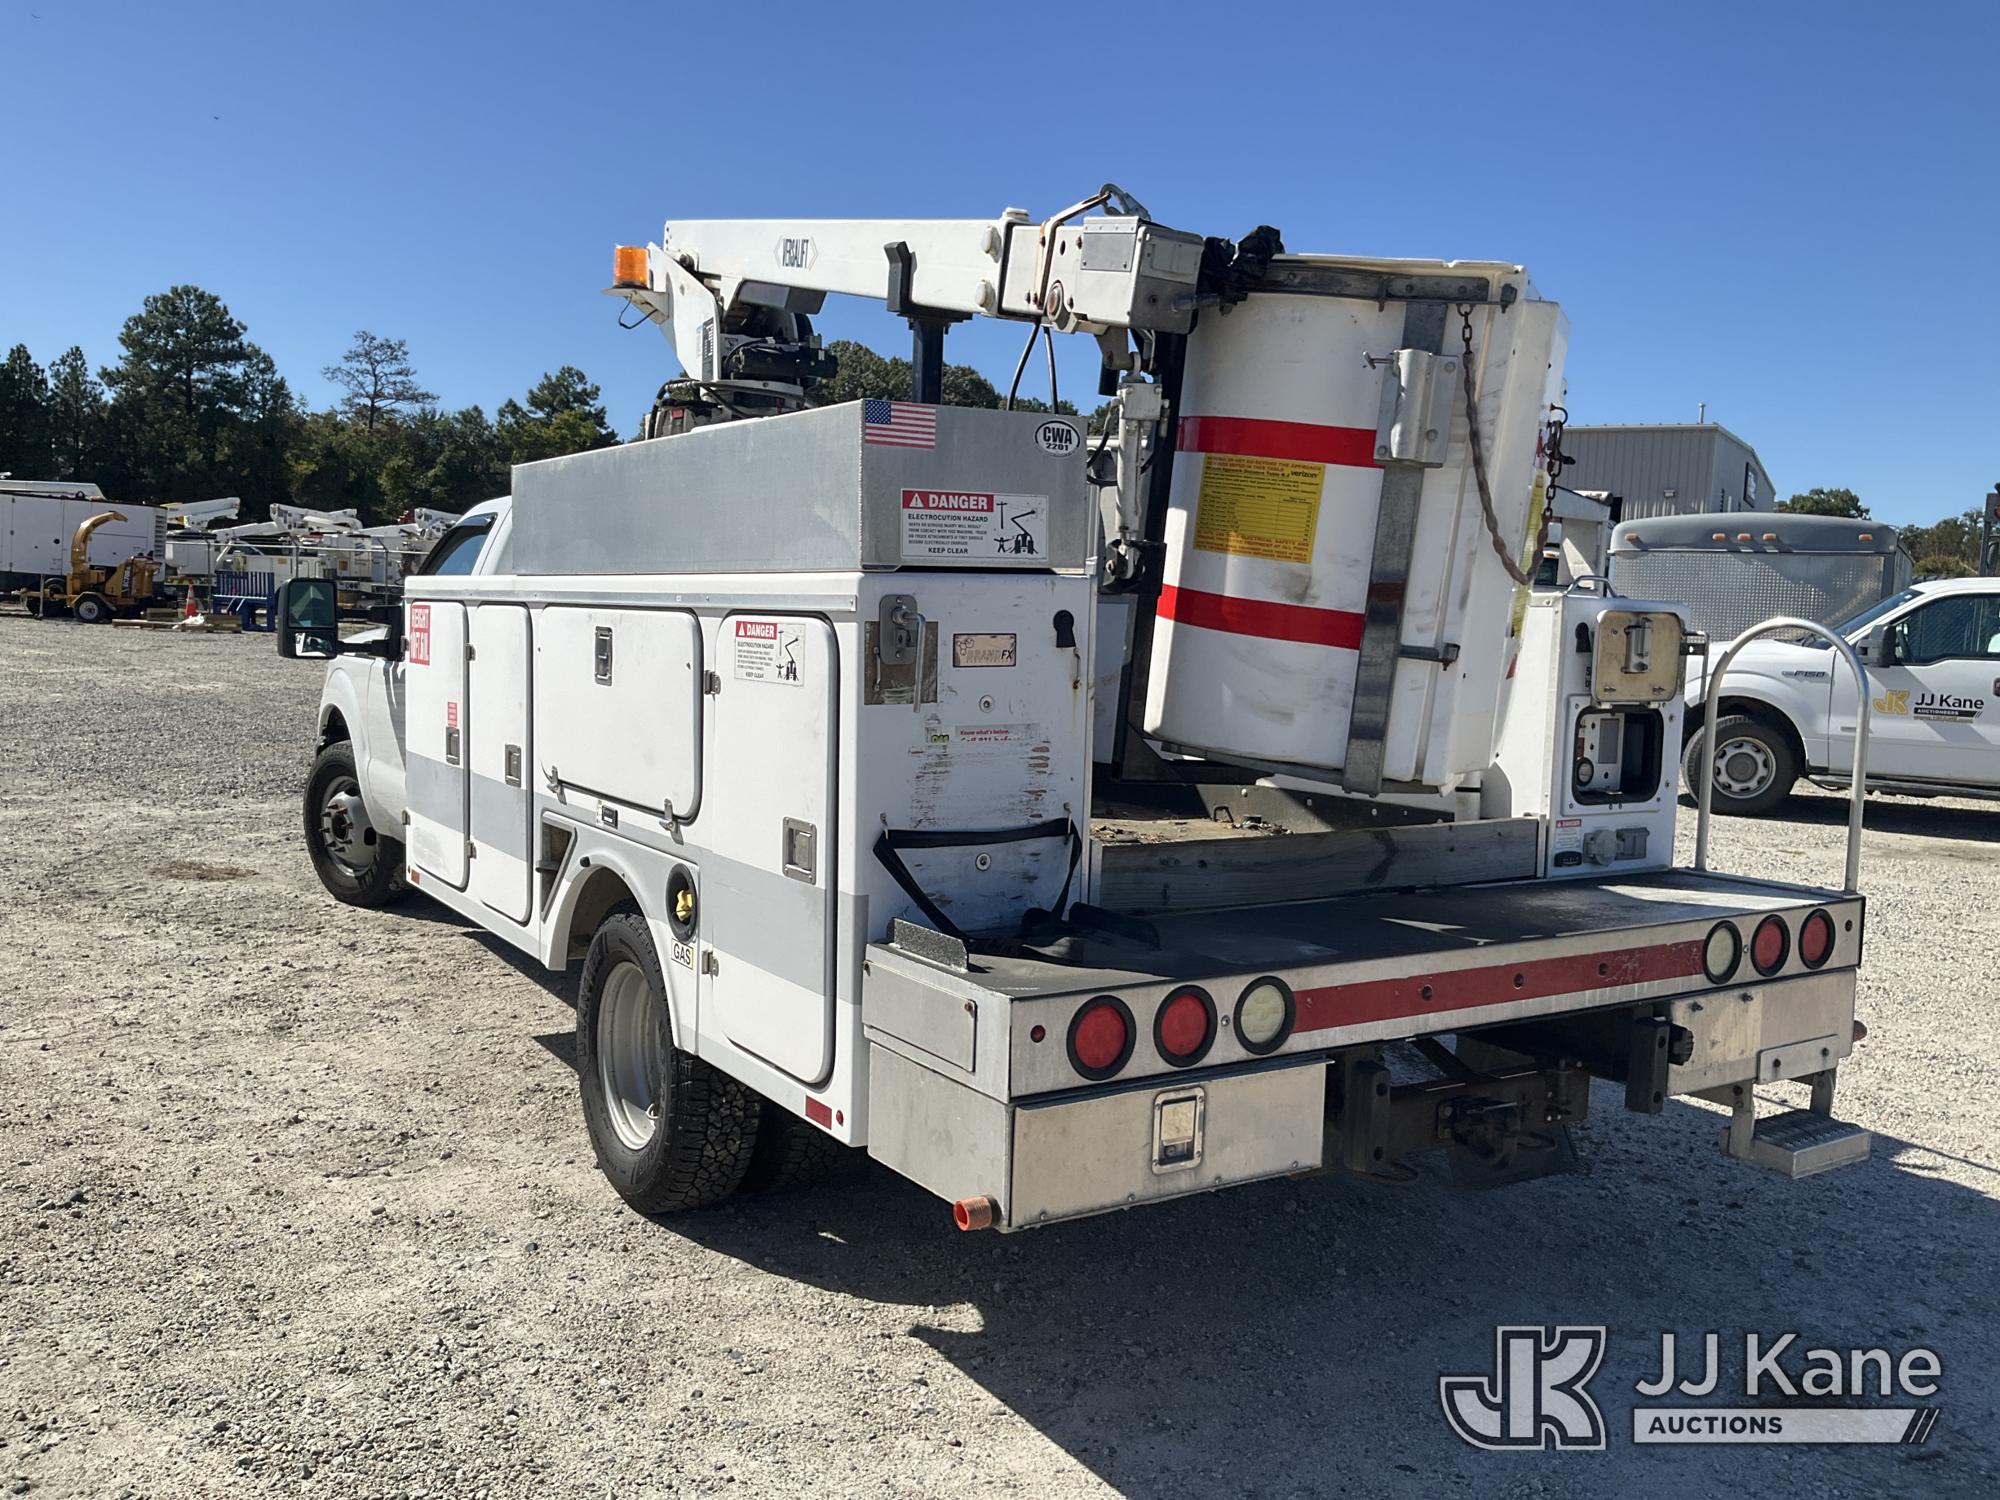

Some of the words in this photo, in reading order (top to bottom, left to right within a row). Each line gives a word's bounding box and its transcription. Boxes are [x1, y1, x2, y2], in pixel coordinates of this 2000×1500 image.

[1043, 426, 1072, 444] CWA
[1045, 443, 1069, 451] 2201
[1290, 470, 1317, 478] verizon
[928, 494, 988, 510] DANGER
[908, 513, 961, 521] ELECTROCUTION
[746, 623, 775, 638] DANGER
[1914, 693, 1935, 706] JJ
[1939, 694, 1984, 709] Kane
[673, 943, 691, 965] GAS
